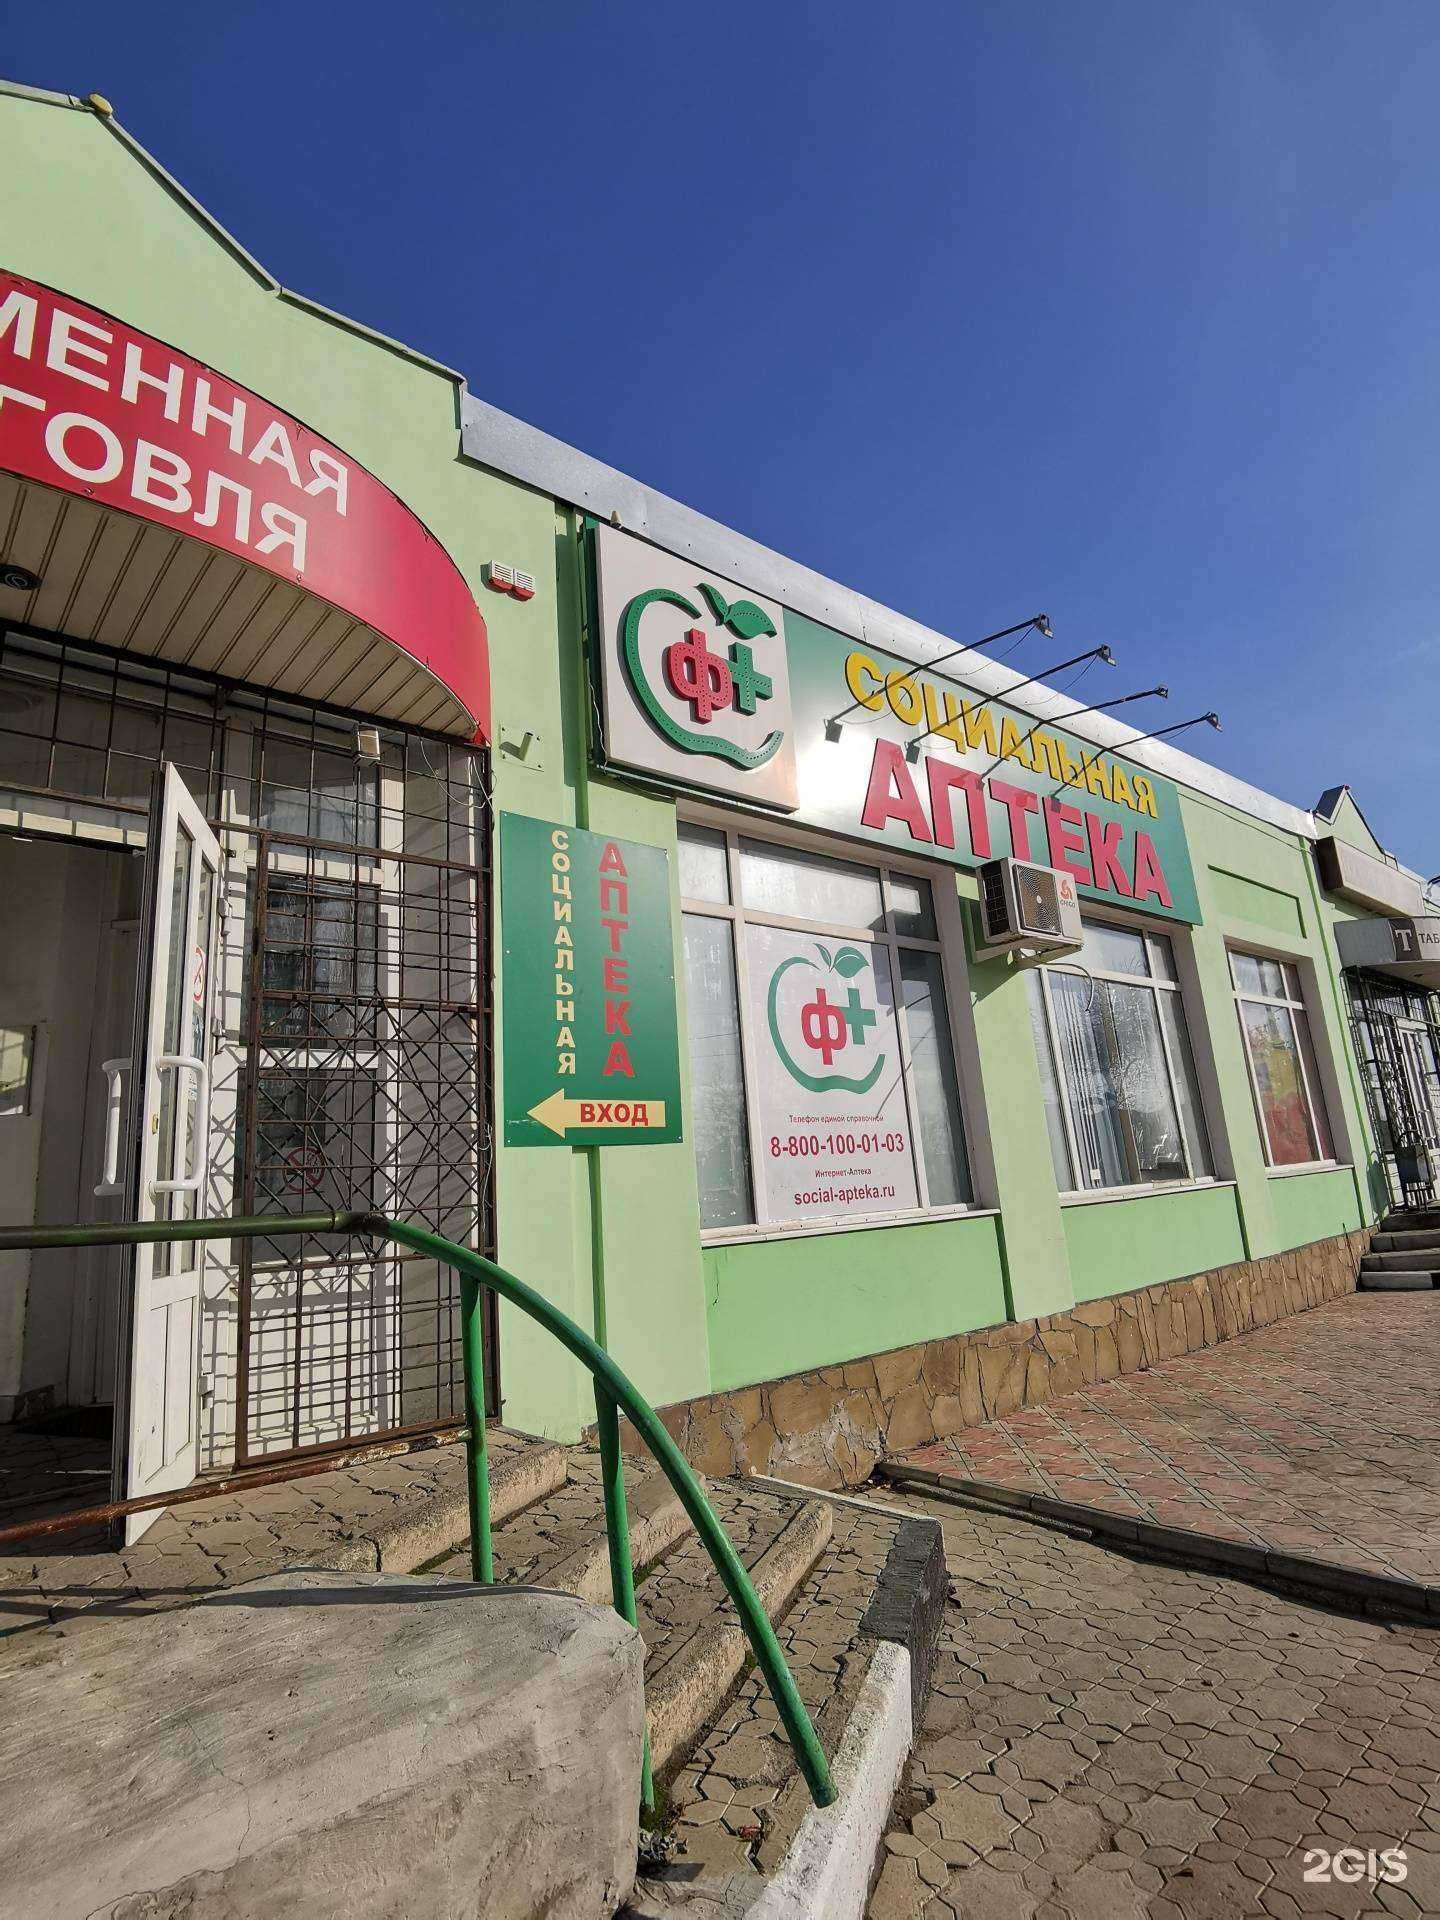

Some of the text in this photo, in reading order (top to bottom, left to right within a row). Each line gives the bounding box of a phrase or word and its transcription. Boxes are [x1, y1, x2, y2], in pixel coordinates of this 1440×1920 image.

[845, 651, 1158, 819] СОЦИАЛЬНАЯ
[861, 738, 1173, 908] АПТЕКА
[551, 830, 576, 1075] СОЦИАЛЬНАЯ
[598, 842, 635, 1078] АПТЕКА
[580, 1103, 649, 1126] ВХОД
[789, 1114, 819, 1124] Телефон
[821, 1114, 845, 1124] единой
[770, 1133, 904, 1157] 8-800-100-01-03
[815, 1167, 872, 1178] Интернет-Аптека
[794, 1184, 895, 1205] social-apteka.ru
